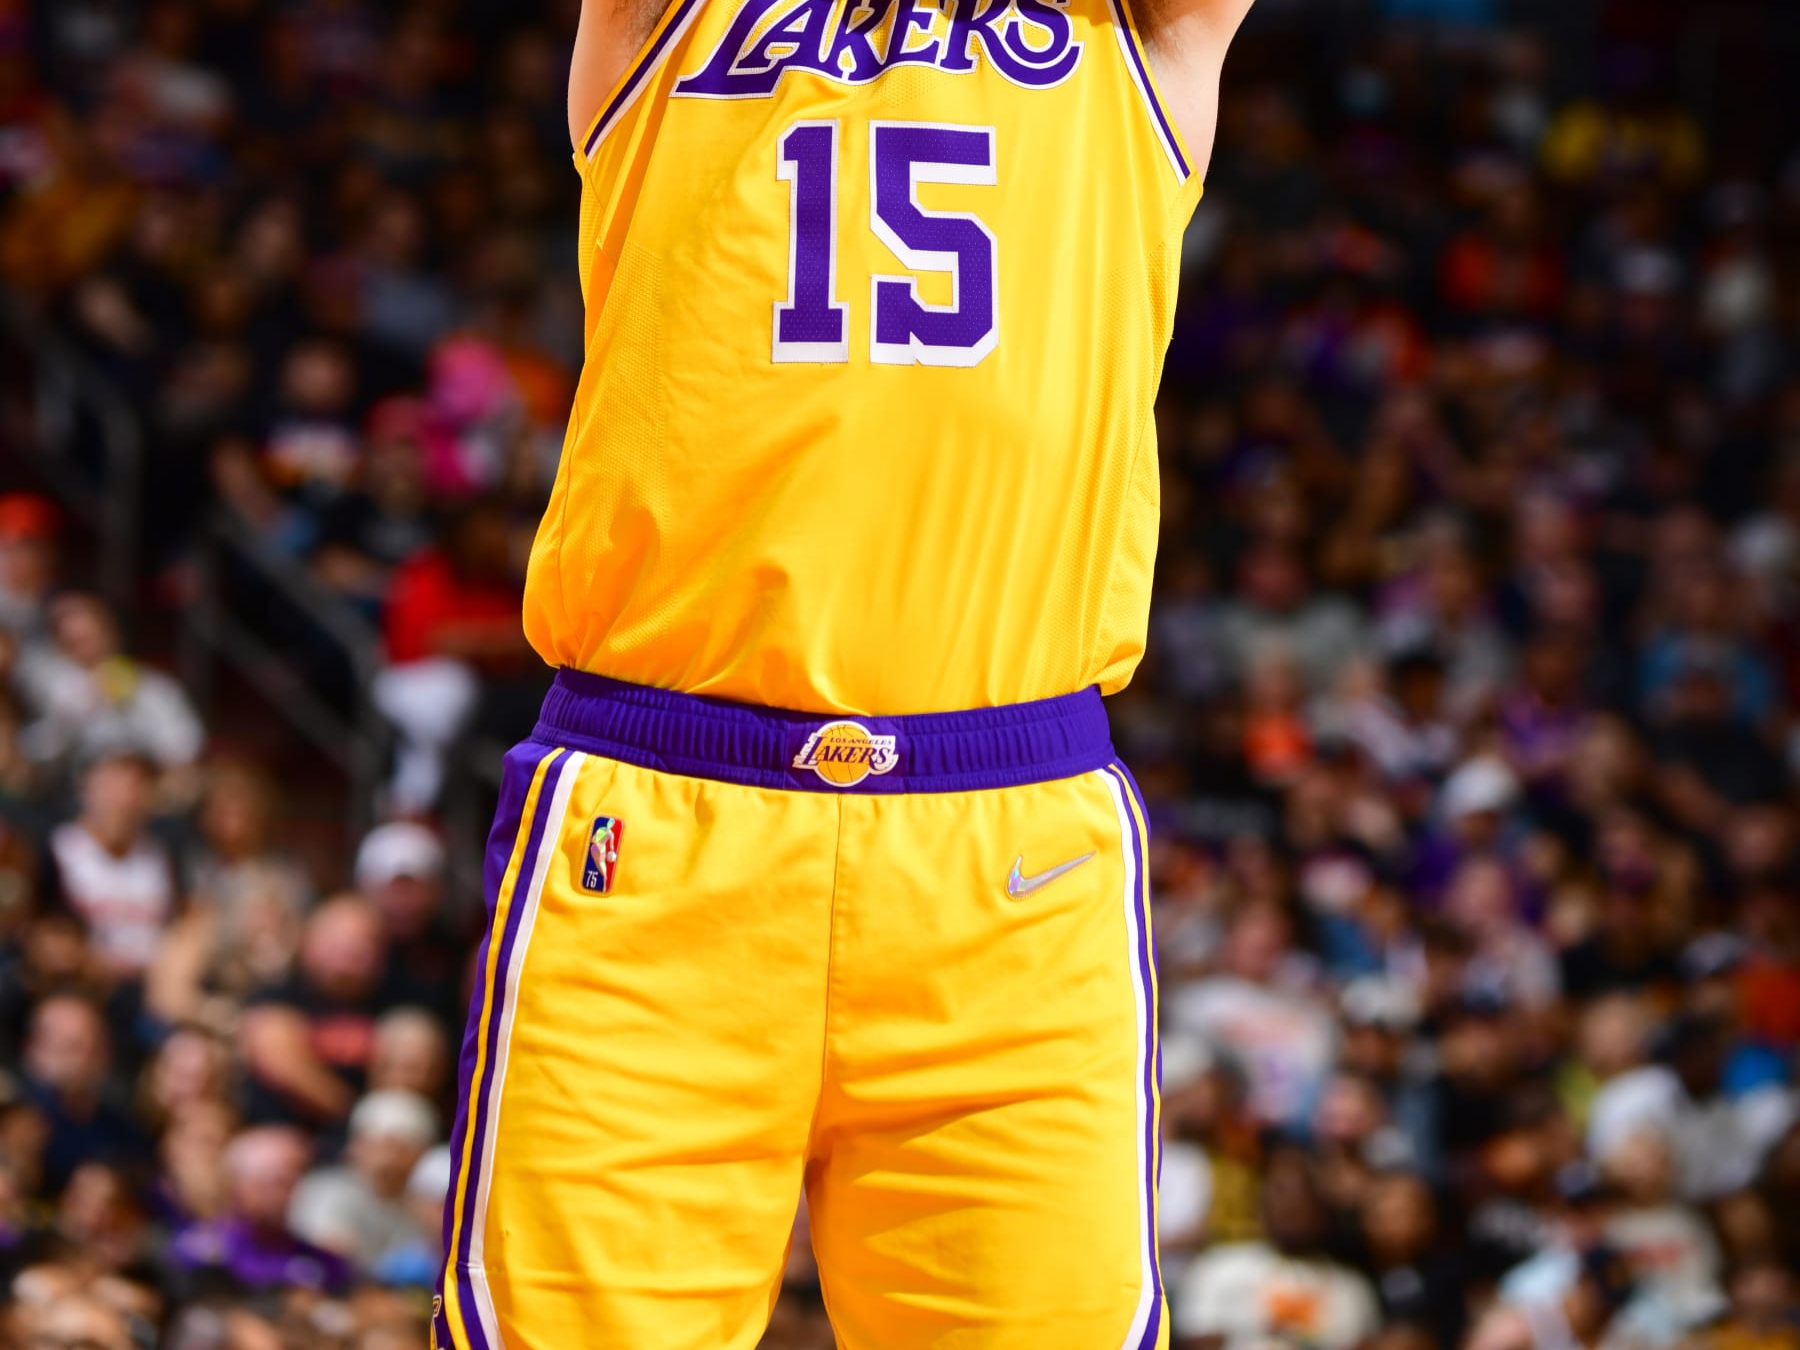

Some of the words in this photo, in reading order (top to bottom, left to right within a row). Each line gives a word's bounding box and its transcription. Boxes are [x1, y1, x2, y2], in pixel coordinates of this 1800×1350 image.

[771, 118, 1000, 369] 15
[800, 736, 893, 771] LAKERS
[829, 736, 847, 744] LOS
[847, 737, 893, 746] ANGELES
[585, 870, 599, 888] 75
